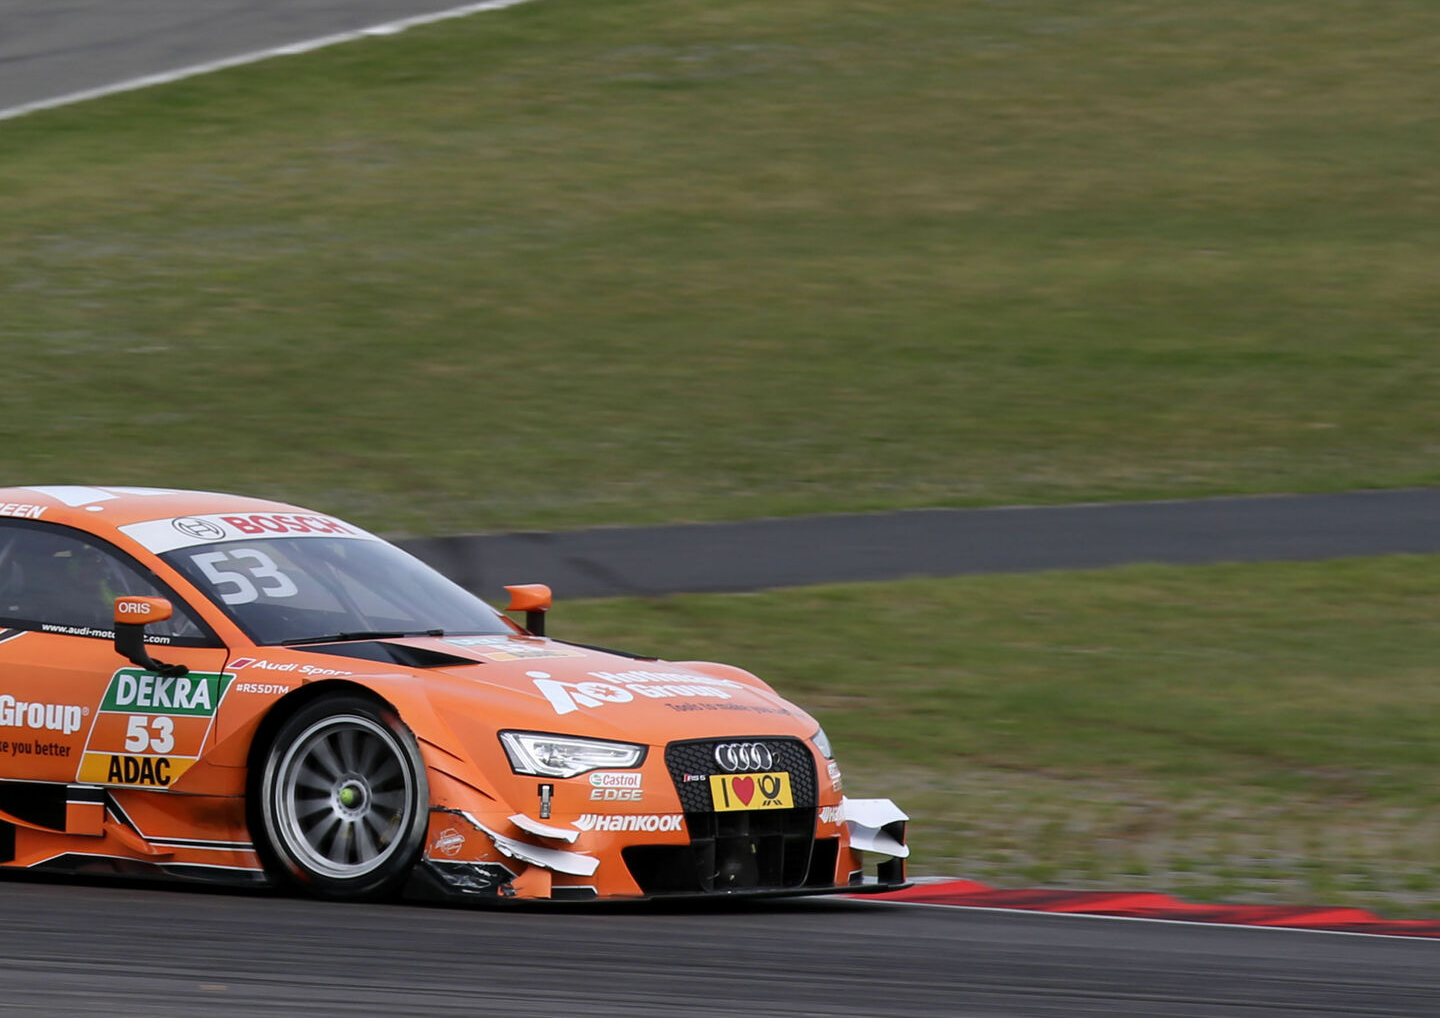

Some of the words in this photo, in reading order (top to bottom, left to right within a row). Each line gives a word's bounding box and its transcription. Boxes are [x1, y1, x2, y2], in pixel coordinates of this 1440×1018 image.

[221, 515, 356, 535] BOSCH
[190, 548, 298, 605] 53
[118, 601, 151, 615] ORIS
[251, 660, 299, 672] Audi
[298, 664, 353, 676] Sport
[115, 674, 212, 710] DEKRA
[235, 683, 290, 695] #RS5DTM
[124, 715, 175, 755] 53
[11, 741, 33, 758] you
[35, 741, 72, 757] better
[107, 755, 172, 786] ADAC
[602, 774, 638, 786] Castrol
[589, 789, 644, 801] EDGE
